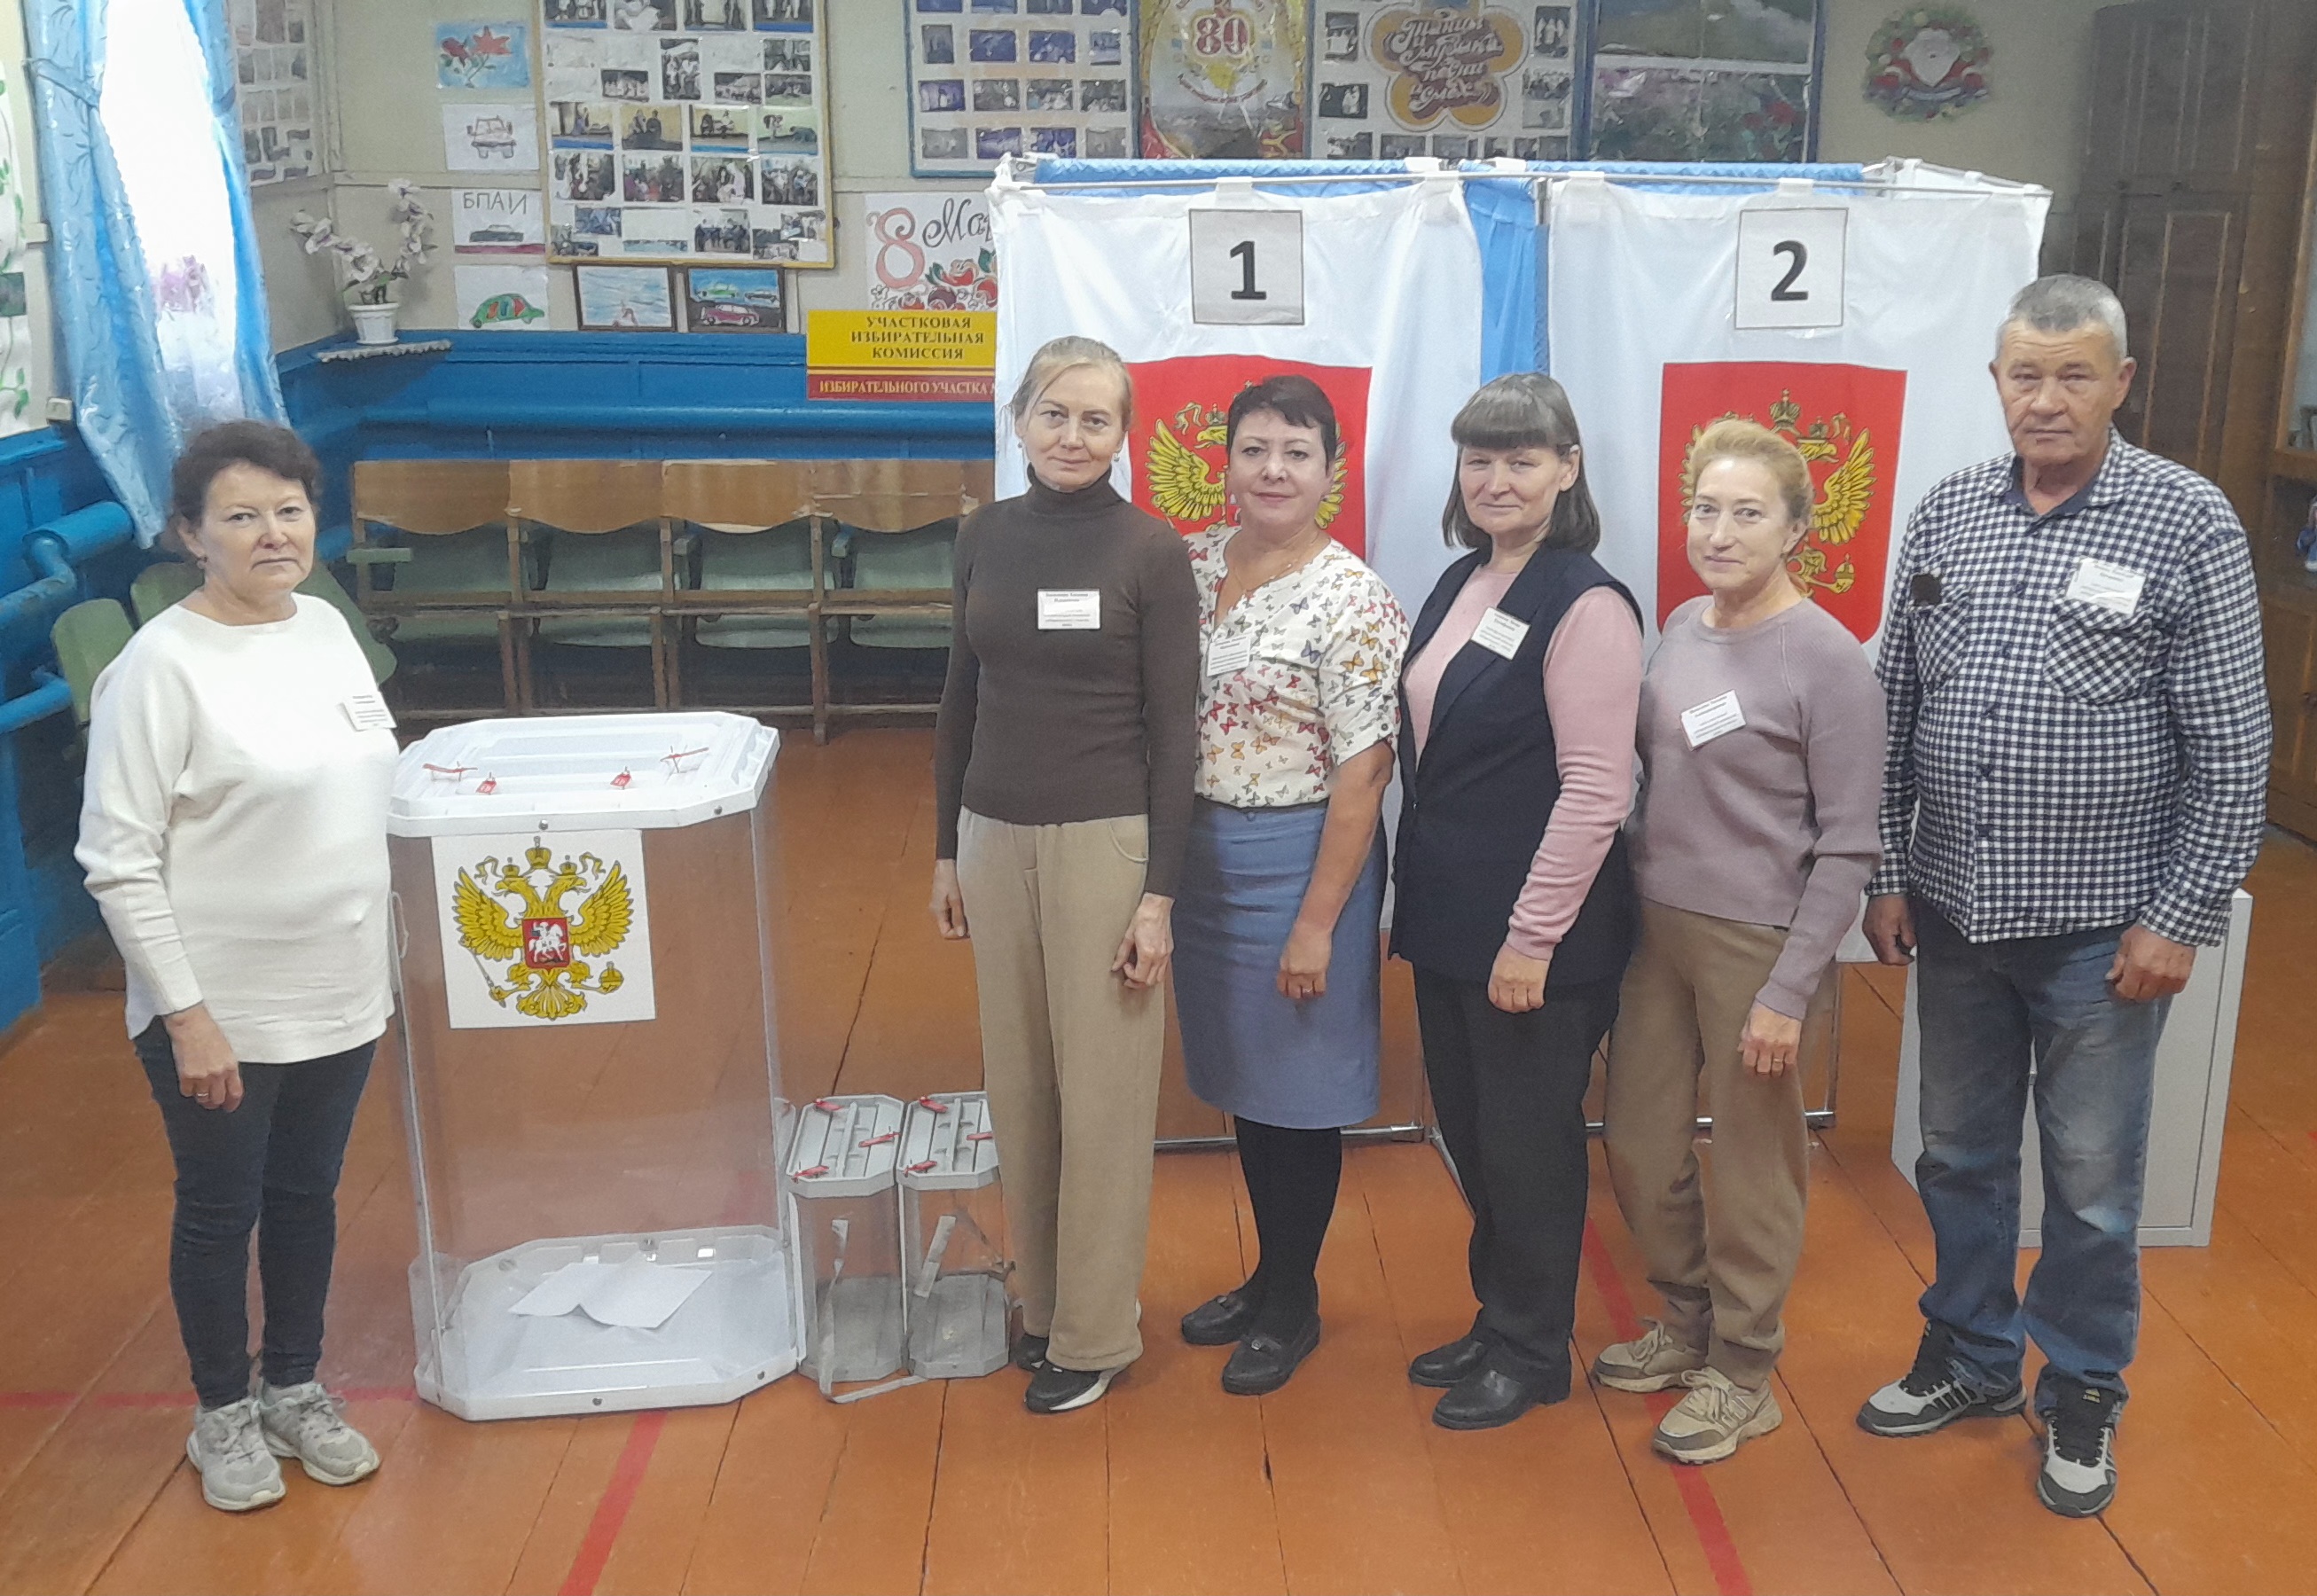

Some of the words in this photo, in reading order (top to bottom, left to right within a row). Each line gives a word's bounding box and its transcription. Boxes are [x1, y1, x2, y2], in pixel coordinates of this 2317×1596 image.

[1196, 16, 1249, 56] 80
[866, 207, 926, 291] 8
[922, 197, 992, 248] Мар
[1230, 240, 1267, 300] 1
[1771, 239, 1809, 301] 2
[865, 316, 972, 329] УЧАСТКОВАЯ
[851, 331, 984, 344] ИЗБИРАТЕЛЬНАЯ
[872, 347, 964, 359] КОМИССИЯ
[819, 380, 930, 394] ИЗБИРАТЕЛЬНОГО
[931, 381, 988, 395] УЧАСТКА
